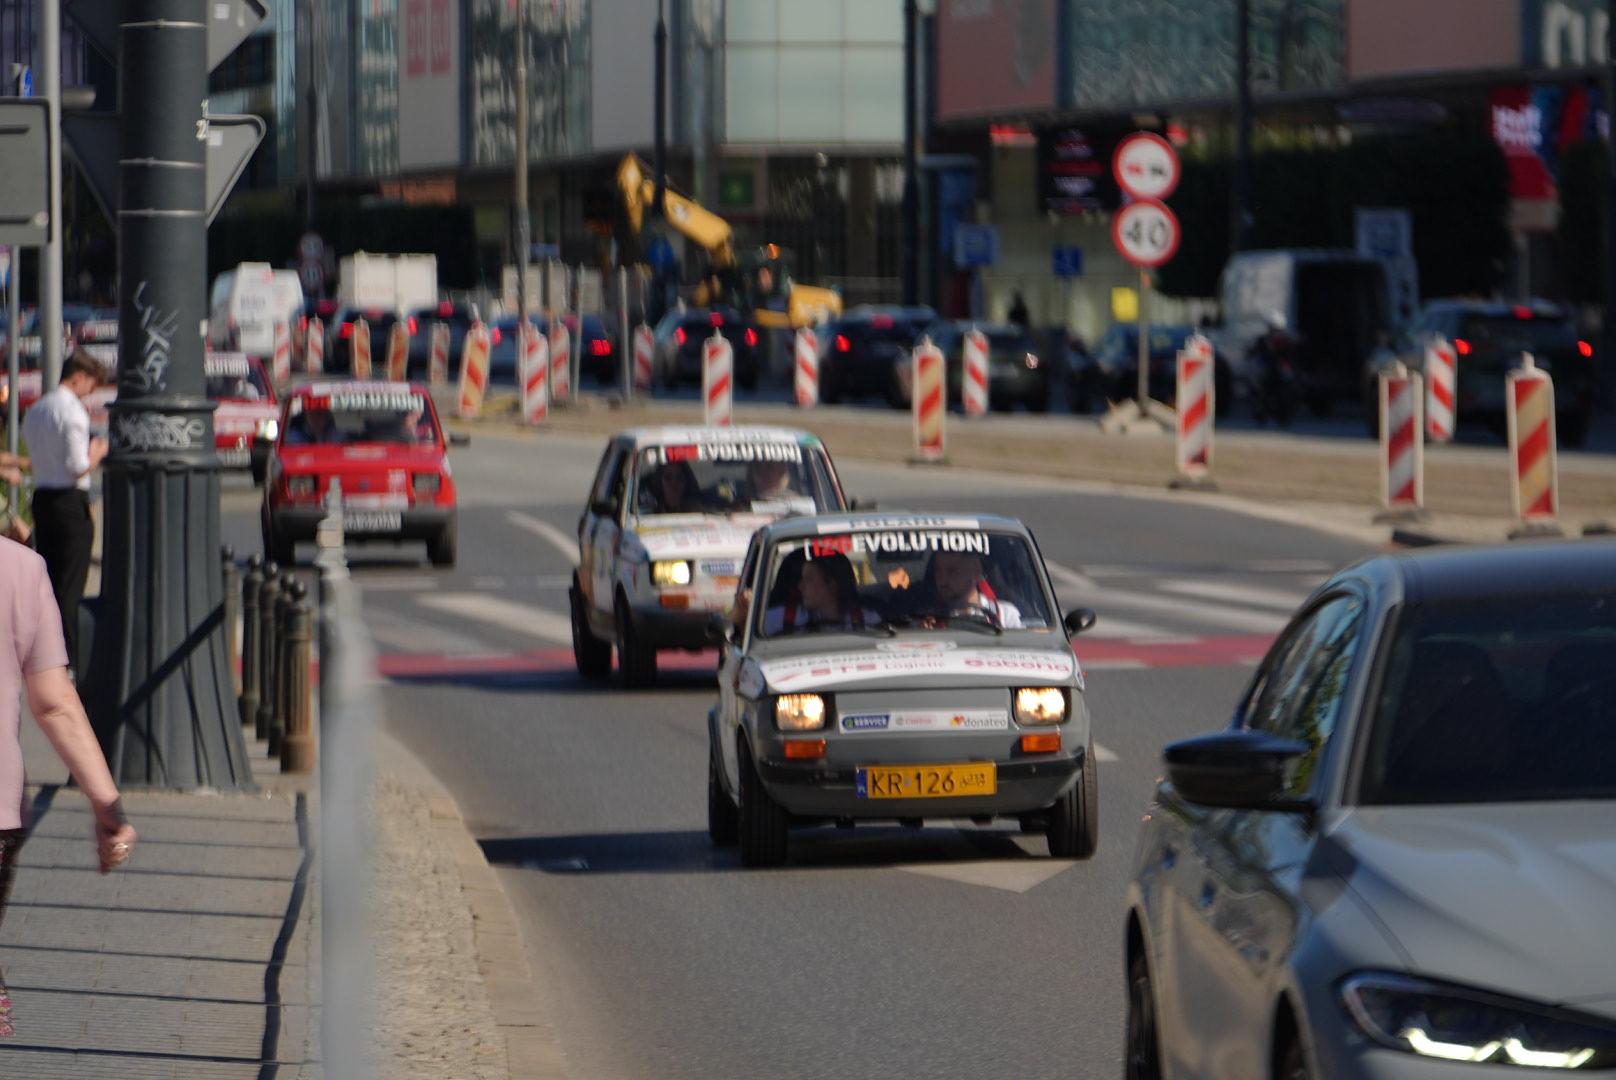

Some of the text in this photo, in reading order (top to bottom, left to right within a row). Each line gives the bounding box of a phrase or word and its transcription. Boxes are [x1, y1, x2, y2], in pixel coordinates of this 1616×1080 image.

[1125, 217, 1169, 247] 40
[871, 771, 903, 795] KR
[916, 770, 955, 795] 126
